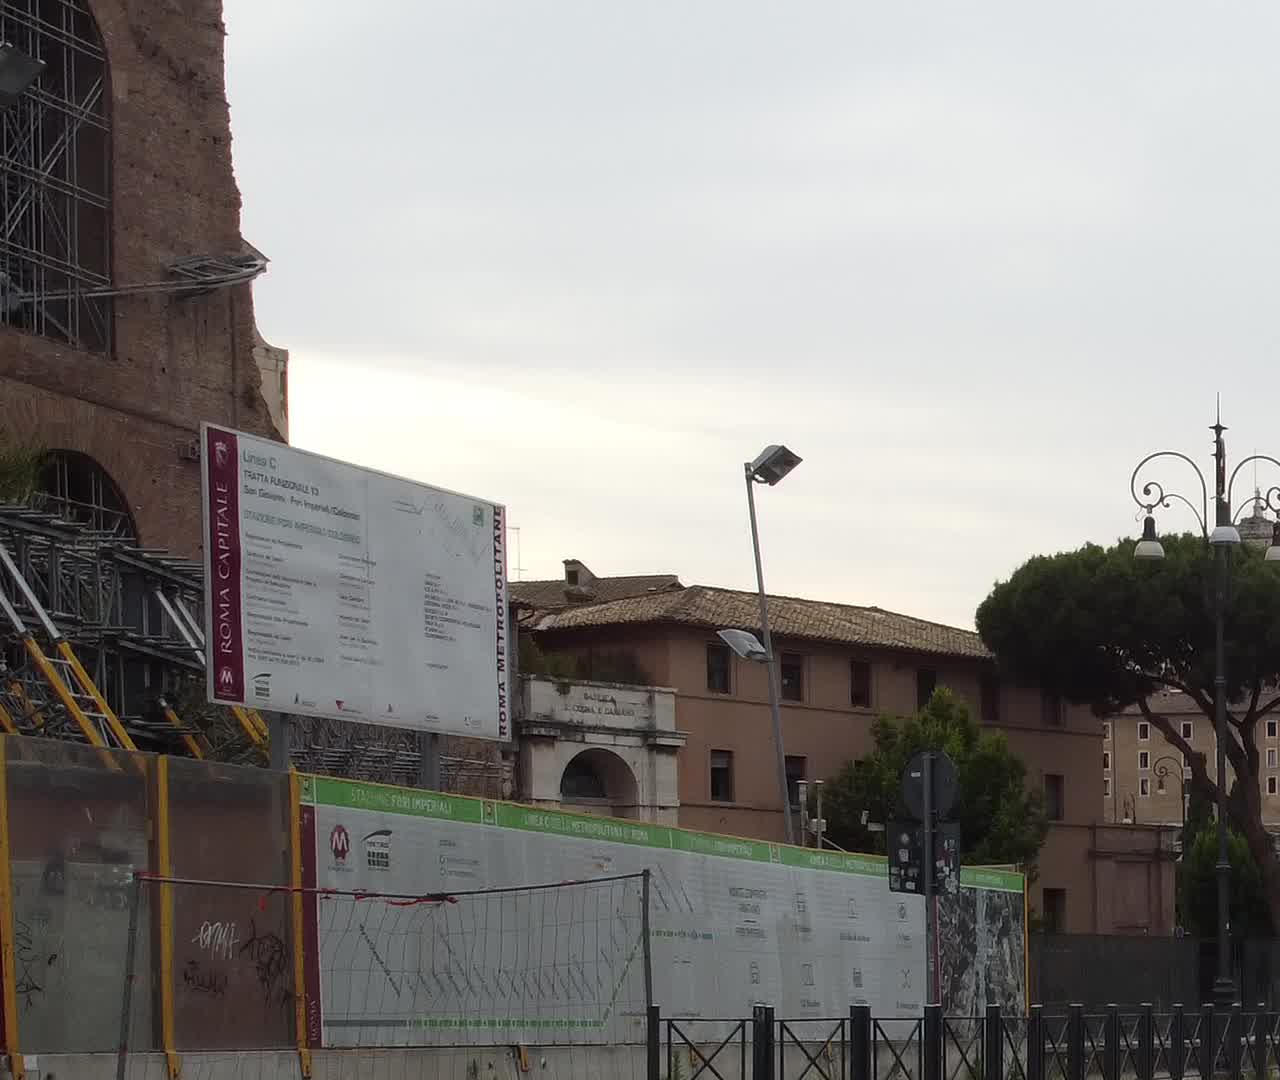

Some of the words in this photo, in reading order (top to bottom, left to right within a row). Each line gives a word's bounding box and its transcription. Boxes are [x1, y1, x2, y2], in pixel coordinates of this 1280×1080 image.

[216, 480, 230, 580] CAPITALE
[217, 588, 232, 654] ROMA
[494, 505, 506, 672] METROPOLITANE
[498, 681, 508, 738] ROMA
